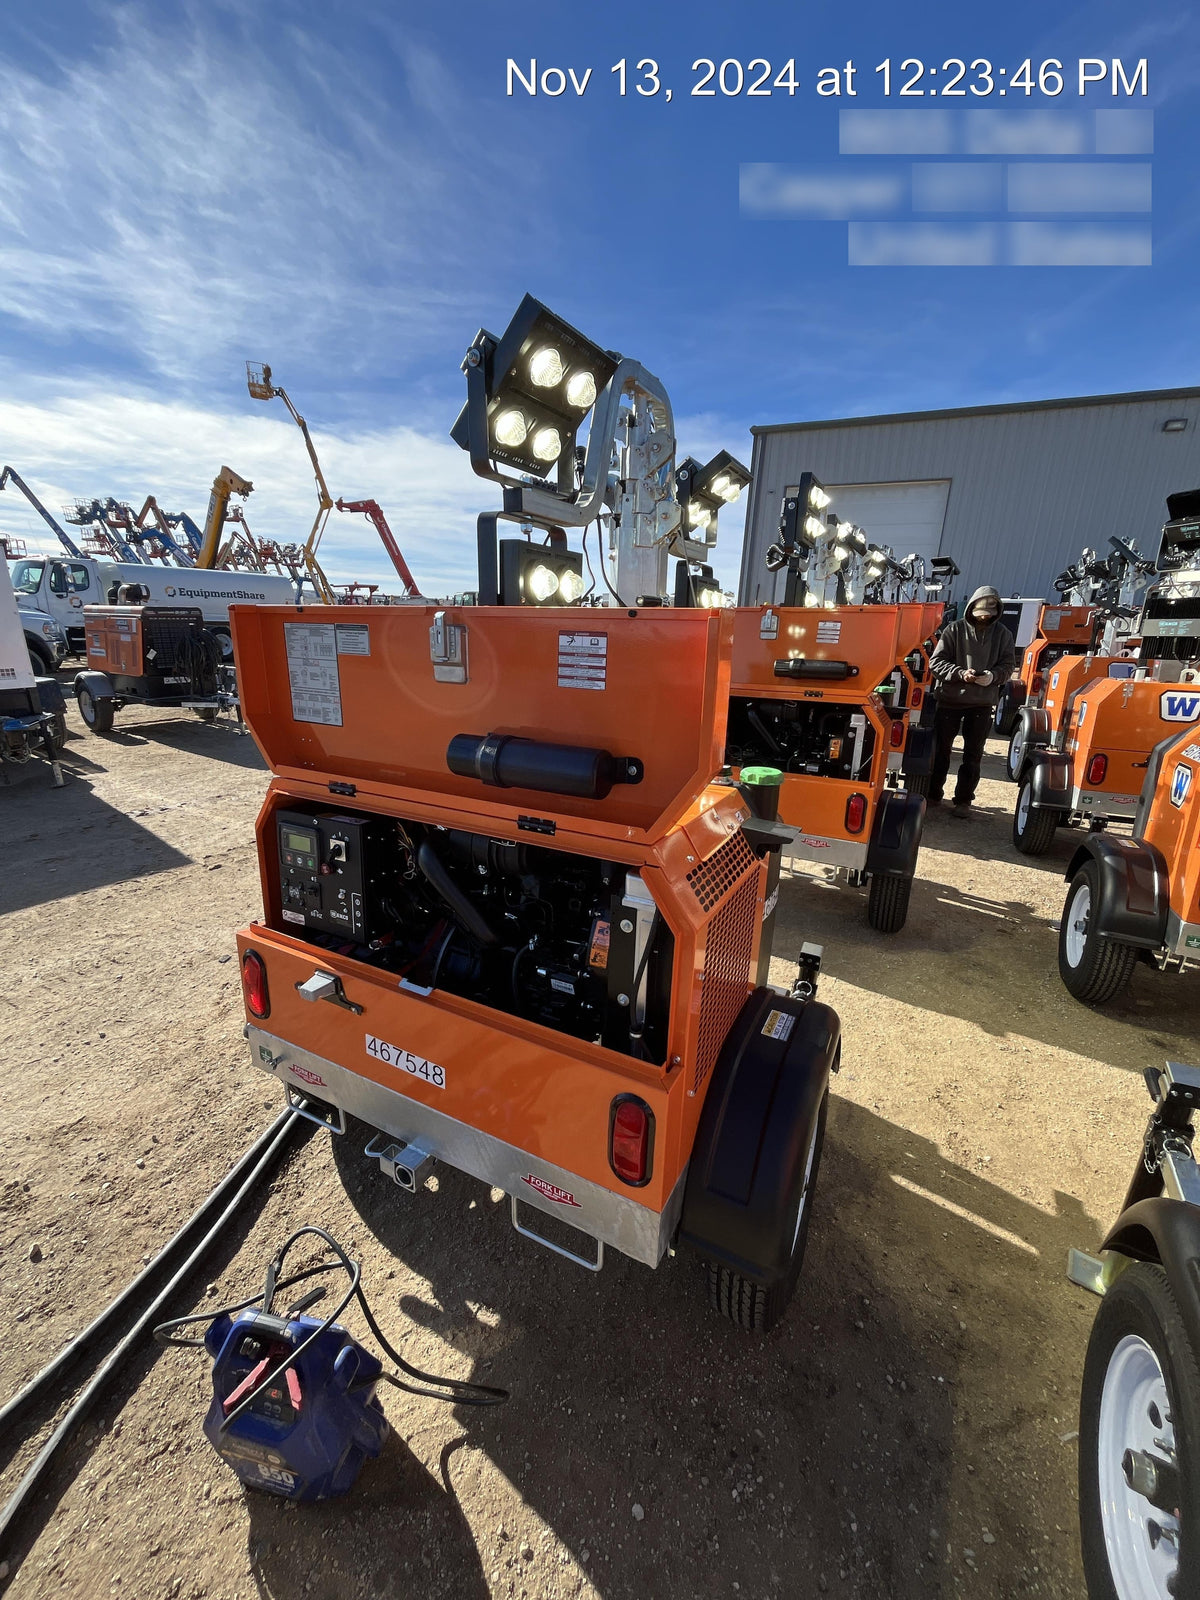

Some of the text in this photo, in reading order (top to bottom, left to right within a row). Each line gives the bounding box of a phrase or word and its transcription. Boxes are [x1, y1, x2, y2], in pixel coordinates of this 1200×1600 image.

[178, 587, 265, 600] EquipmentShare
[1166, 696, 1200, 717] W
[367, 1037, 444, 1086] 467548
[530, 1176, 553, 1193] FORK
[553, 1187, 571, 1201] LIFT
